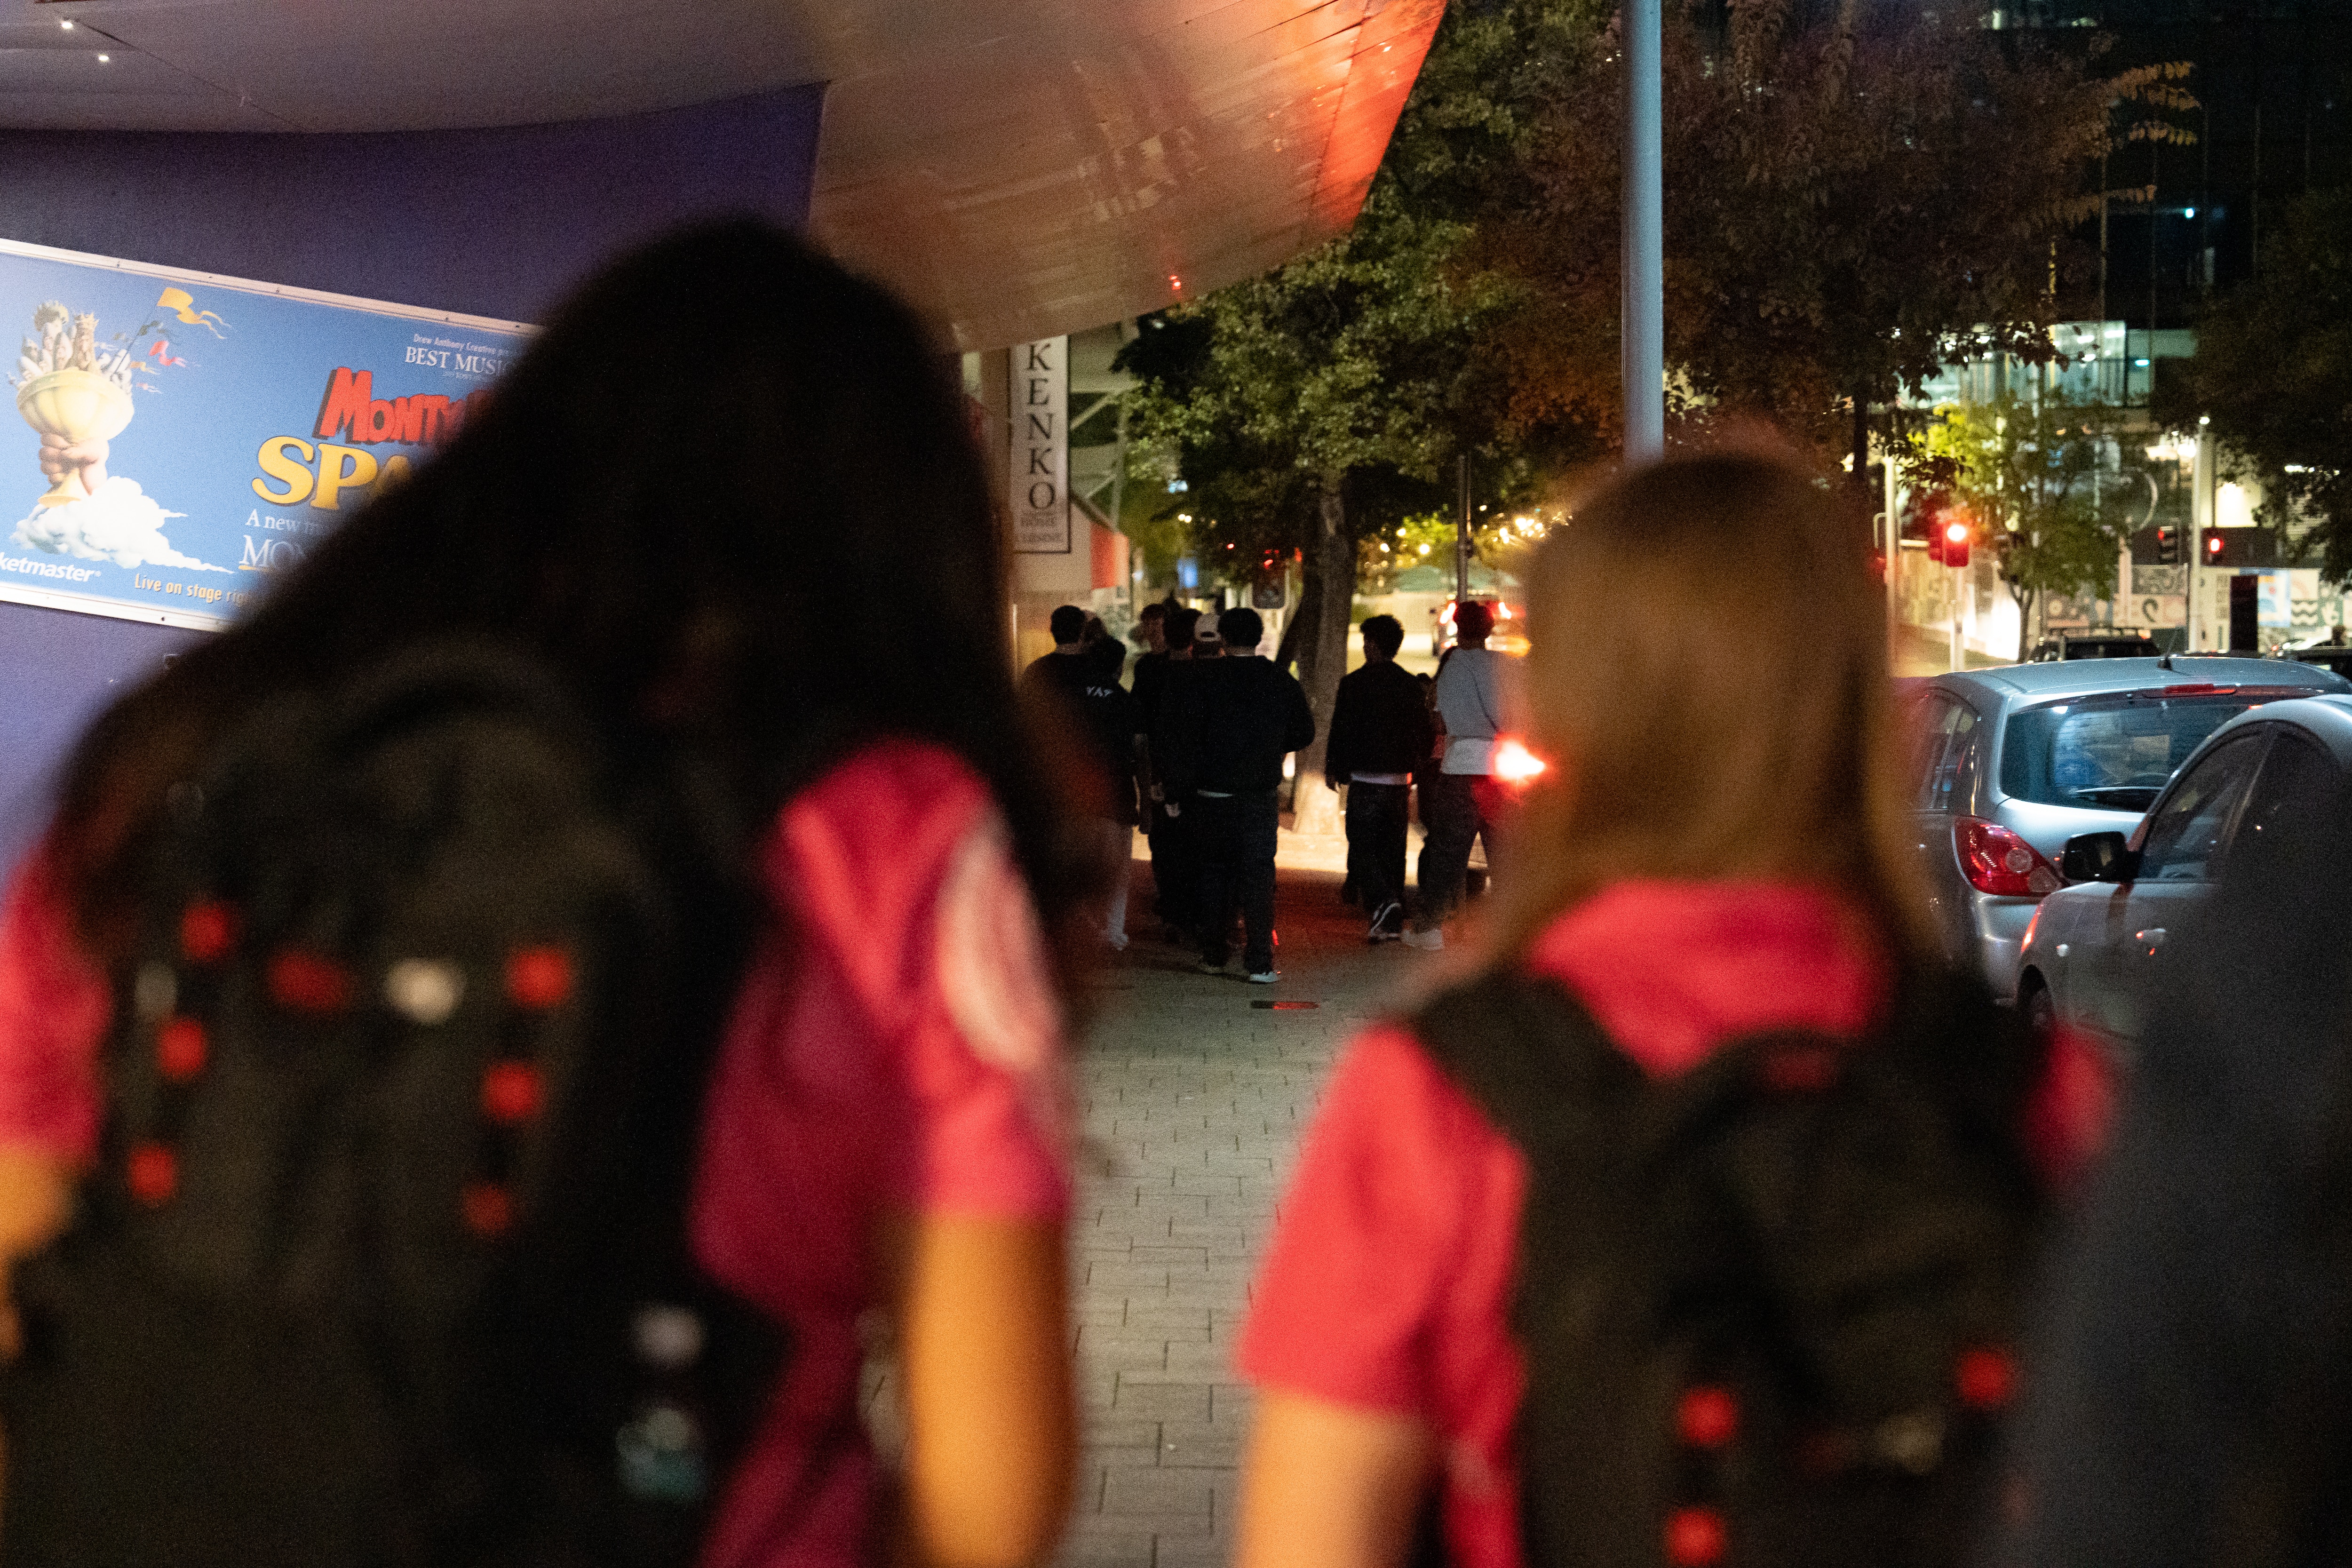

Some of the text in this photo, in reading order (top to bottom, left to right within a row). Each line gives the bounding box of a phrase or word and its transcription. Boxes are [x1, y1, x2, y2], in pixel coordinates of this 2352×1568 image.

[405, 346, 451, 368] BEST
[1027, 343, 1055, 509] KENKO
[245, 509, 261, 527] A
[263, 516, 301, 533] new
[135, 573, 161, 591] Live
[166, 582, 182, 595] on
[187, 584, 222, 604] stage
